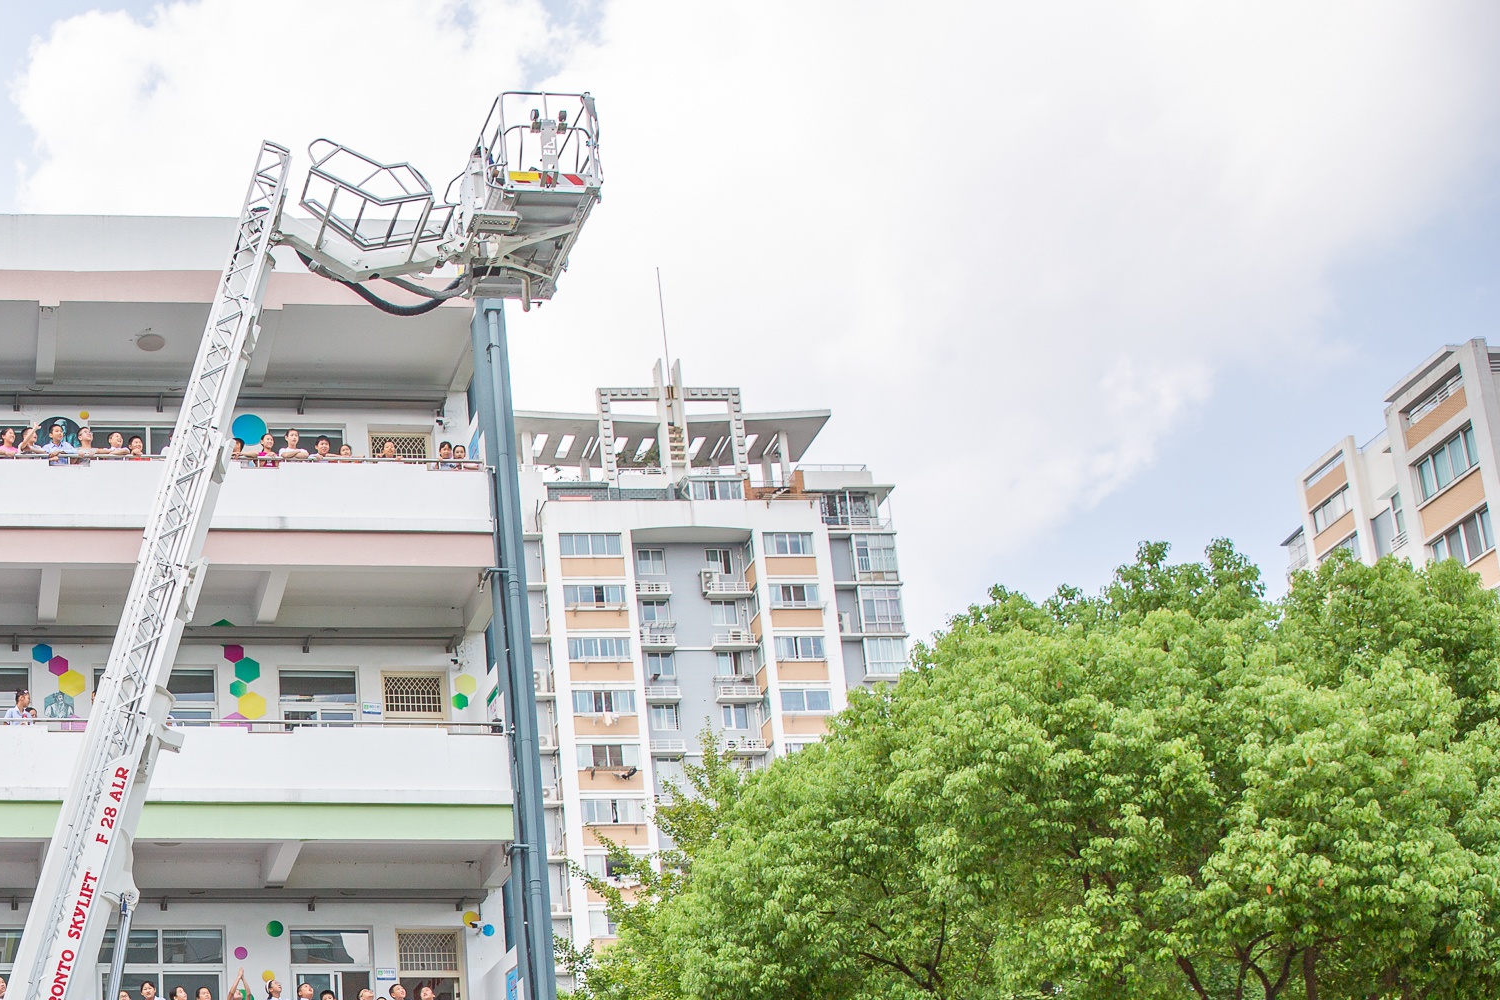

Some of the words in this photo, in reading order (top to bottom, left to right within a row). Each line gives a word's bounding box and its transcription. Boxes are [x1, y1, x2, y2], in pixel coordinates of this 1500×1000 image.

[109, 766, 129, 802] ALR
[101, 806, 117, 829] 28
[95, 833, 108, 844] F
[67, 871, 98, 940] SKYLIFT
